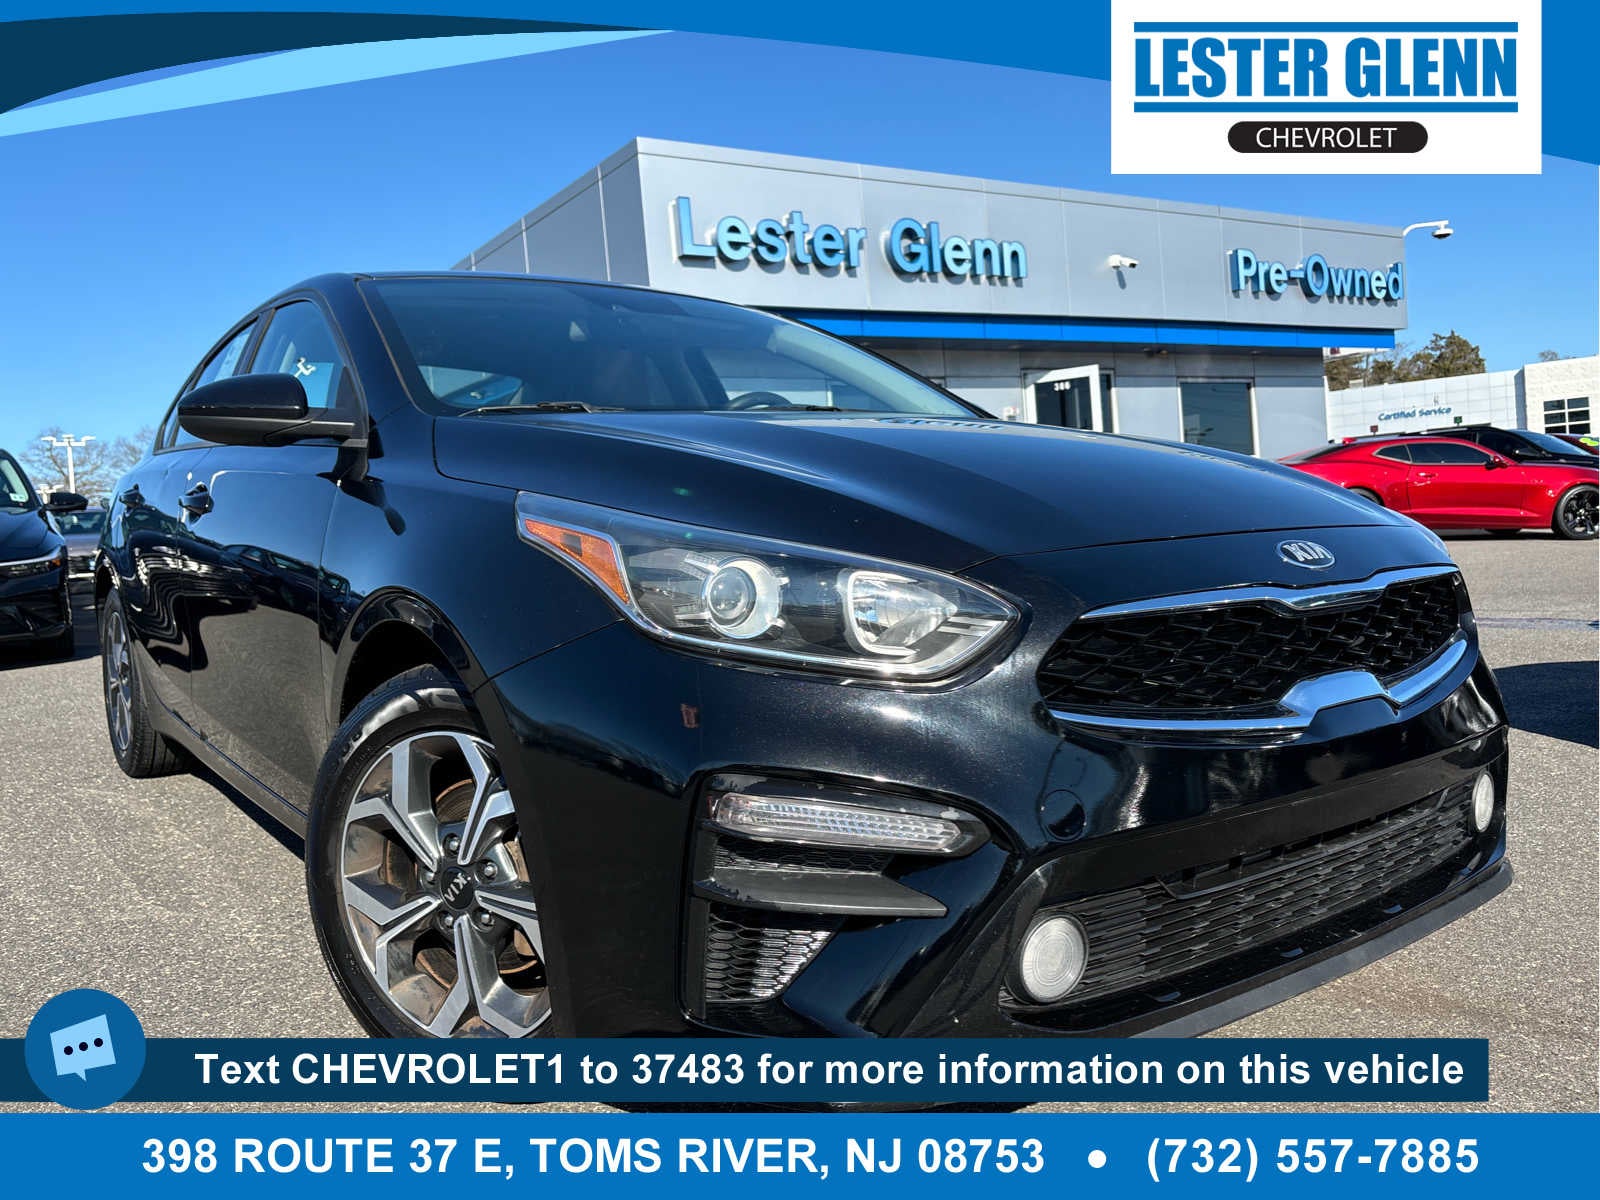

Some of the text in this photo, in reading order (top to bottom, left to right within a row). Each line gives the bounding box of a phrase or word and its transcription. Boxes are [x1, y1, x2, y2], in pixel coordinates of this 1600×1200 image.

[675, 195, 1028, 279] Lester Glenn
[1229, 247, 1404, 301] Pre-Owned
[1378, 406, 1452, 421] Certified Service
[1281, 541, 1333, 562] KIA
